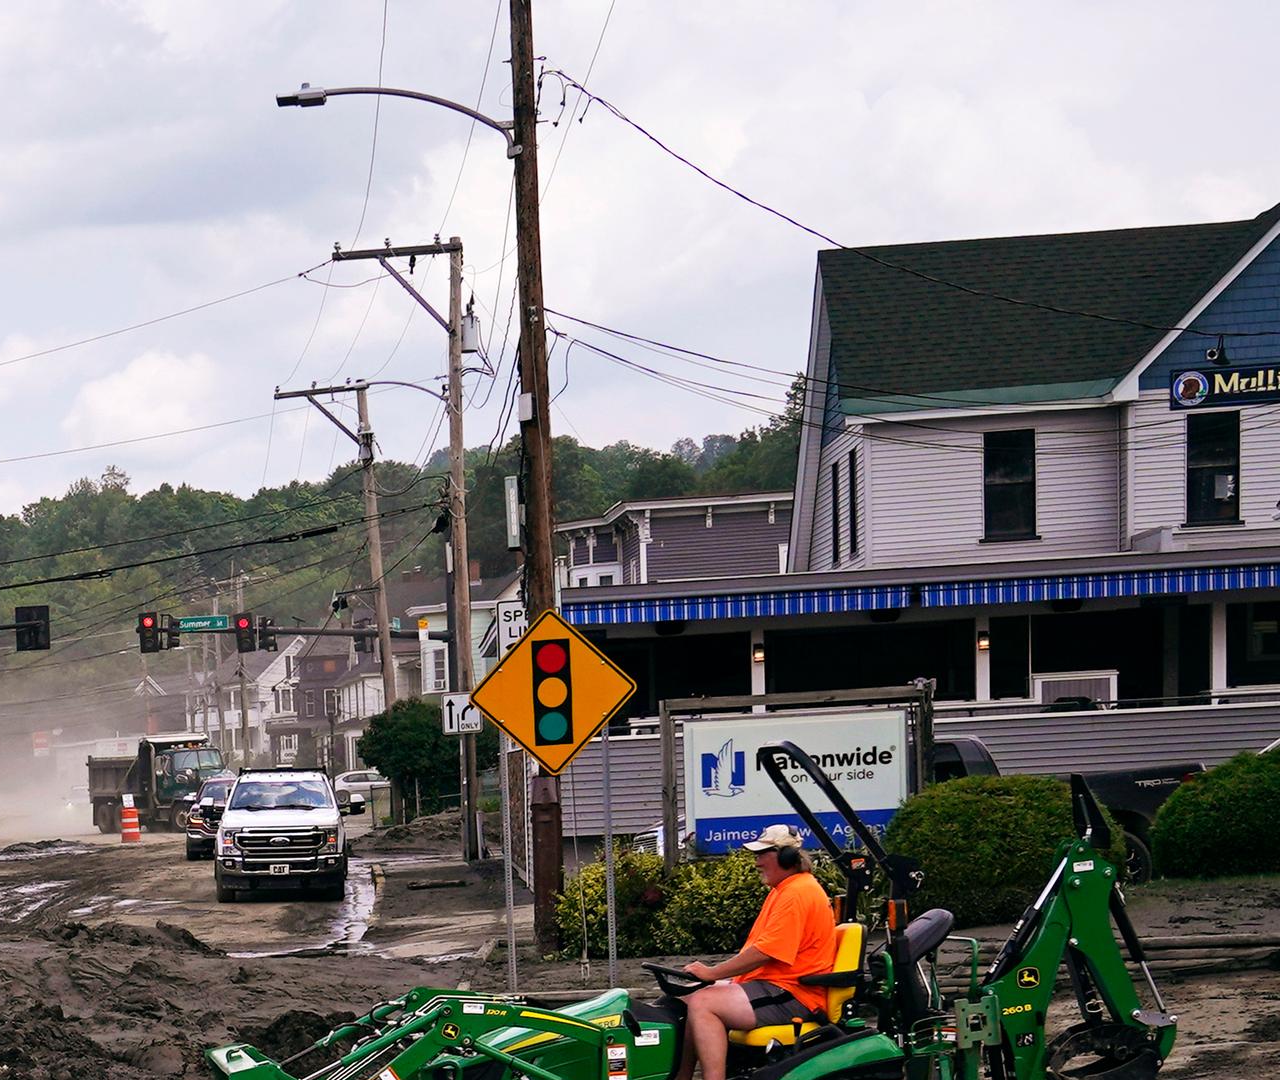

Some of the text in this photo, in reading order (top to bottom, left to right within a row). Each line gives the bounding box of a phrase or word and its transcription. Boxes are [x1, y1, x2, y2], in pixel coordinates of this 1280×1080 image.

[179, 620, 211, 629] Summer
[461, 721, 479, 730] ONLY
[791, 774, 808, 783] on
[847, 769, 874, 780] side
[705, 829, 758, 842] Jaimes
[273, 865, 286, 873] CAT
